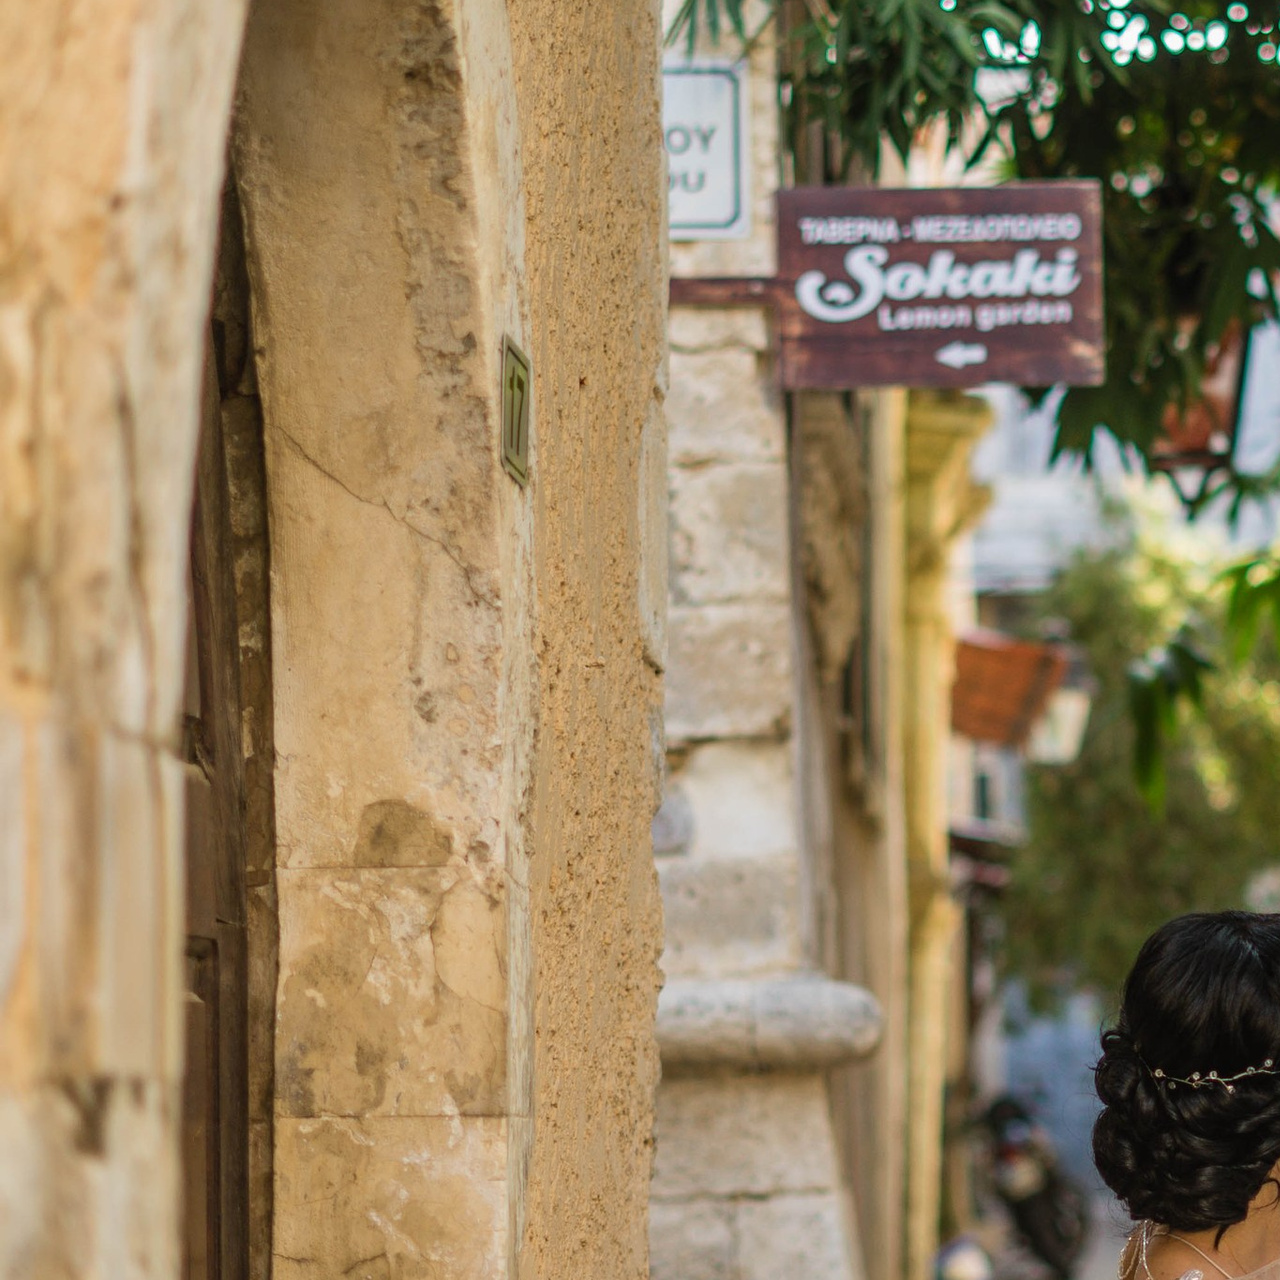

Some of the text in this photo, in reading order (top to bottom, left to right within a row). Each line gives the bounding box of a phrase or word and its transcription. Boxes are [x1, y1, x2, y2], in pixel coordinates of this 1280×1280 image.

[796, 245, 1081, 322] Sokaki
[878, 300, 1072, 330] Lemon garden
[509, 365, 526, 456] 17
